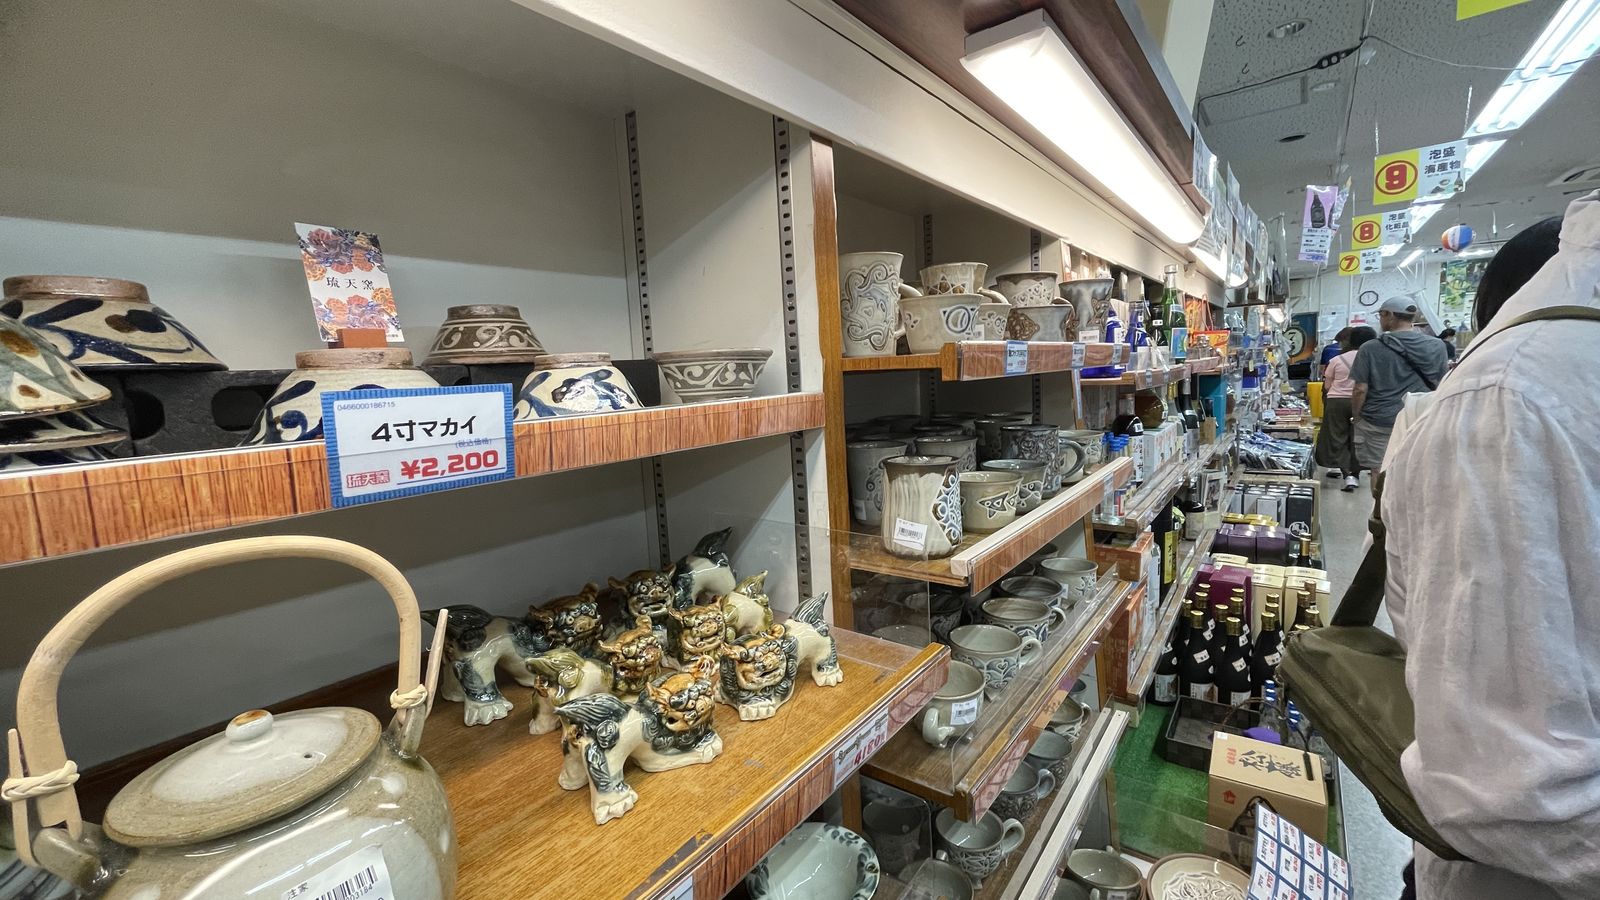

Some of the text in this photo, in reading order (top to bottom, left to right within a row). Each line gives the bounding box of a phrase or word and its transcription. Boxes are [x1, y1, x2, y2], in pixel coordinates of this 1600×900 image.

[1429, 146, 1456, 160] 泡盛
[1424, 160, 1461, 174] 海産物
[1385, 163, 1408, 191] 9
[1360, 223, 1374, 241] 8
[1344, 255, 1356, 270] 7
[371, 416, 477, 442] 4寸マカイ
[401, 449, 499, 480] ¥2,200
